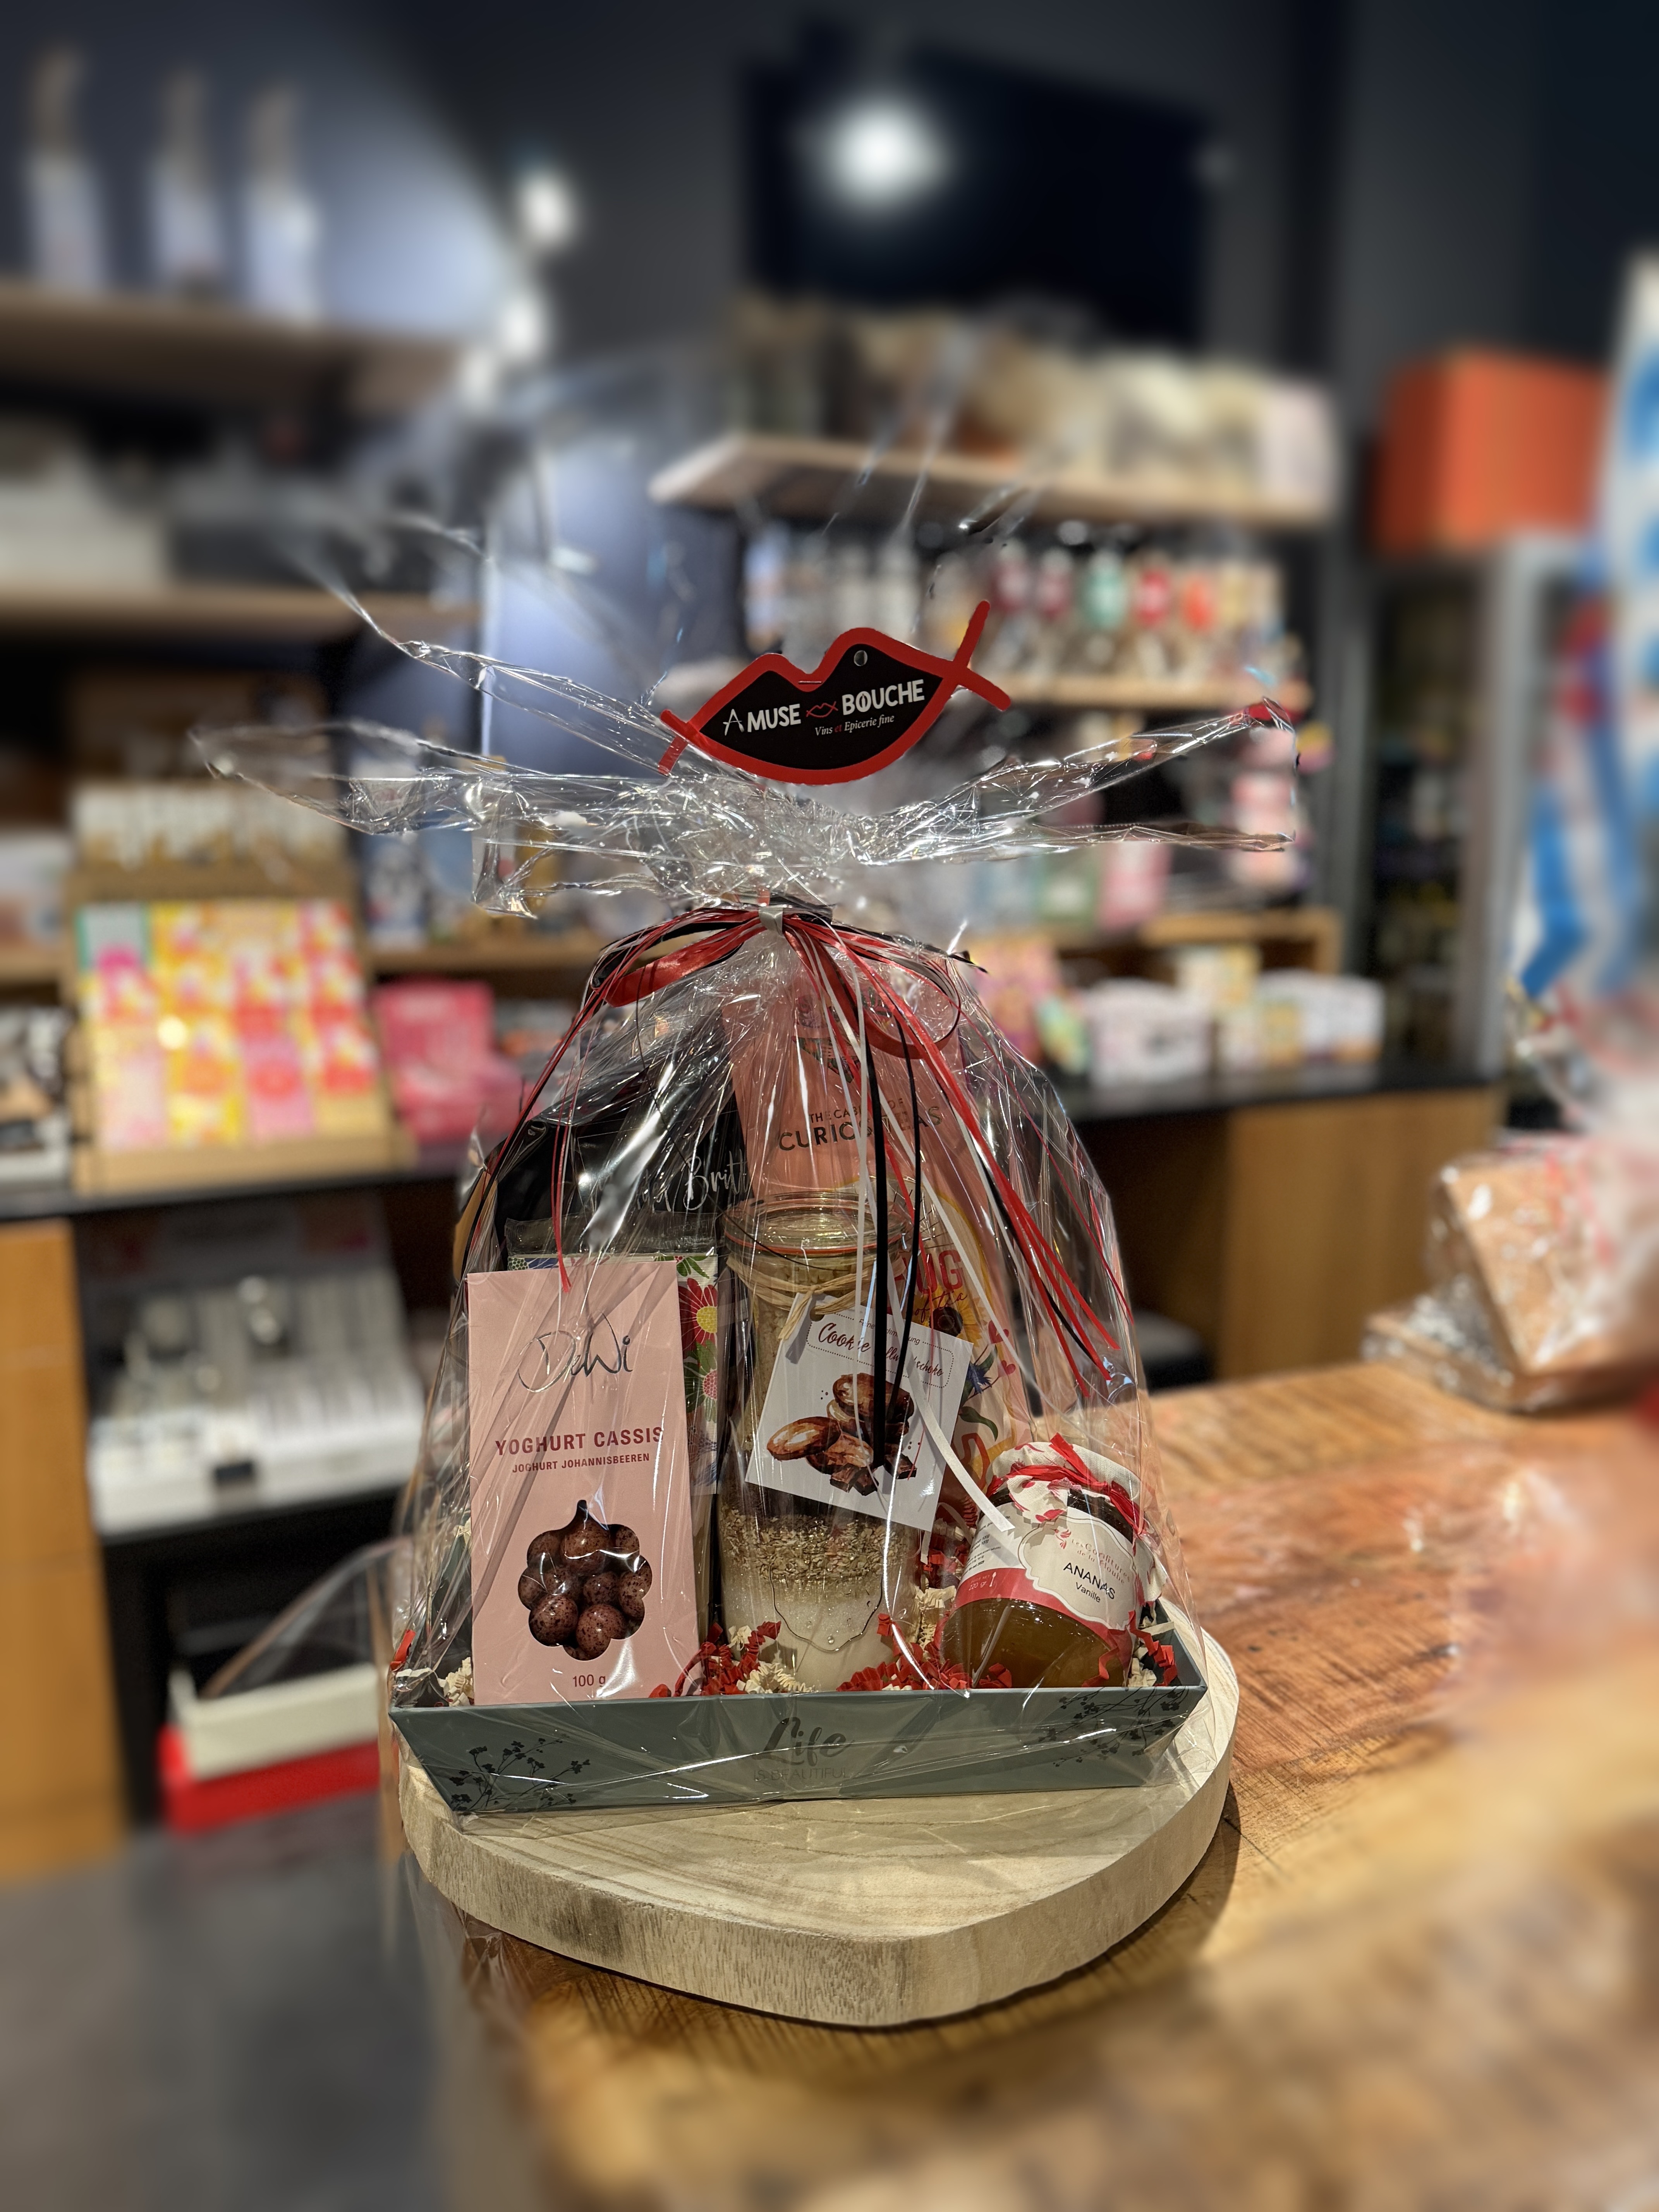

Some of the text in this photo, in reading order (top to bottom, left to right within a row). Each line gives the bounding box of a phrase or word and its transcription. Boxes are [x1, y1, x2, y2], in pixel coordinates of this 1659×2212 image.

[842, 679, 925, 716] BOUCHE
[815, 714, 895, 736] Vins et Epicerie fine
[495, 1427, 663, 1455] YOGHURT CASSIS
[512, 1453, 649, 1473] JOGHURT JOHANNISBEEREN
[1063, 1562, 1115, 1599] ANANAS
[1076, 1582, 1101, 1603] Vanille
[572, 1674, 606, 1687] 100 g
[752, 1717, 856, 1767] Life
[771, 1767, 851, 1781] BEAUTIFUL
